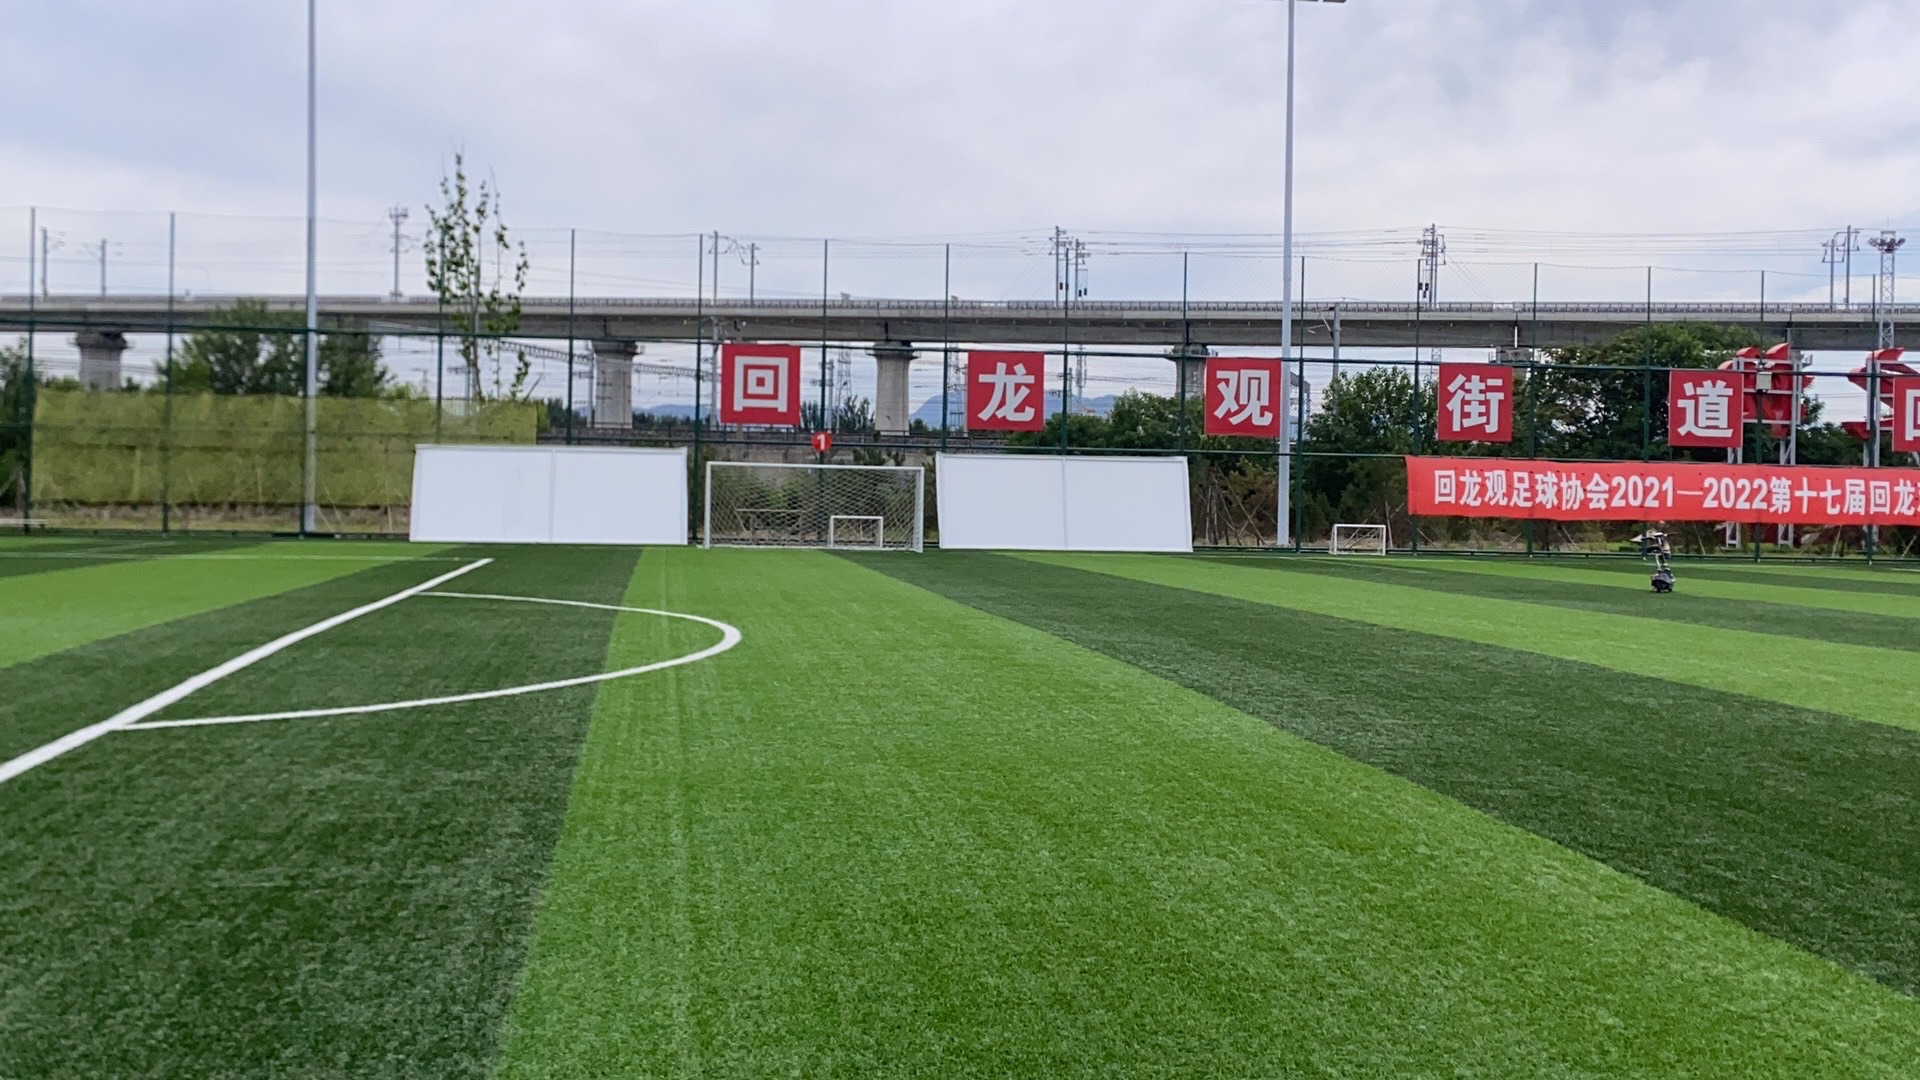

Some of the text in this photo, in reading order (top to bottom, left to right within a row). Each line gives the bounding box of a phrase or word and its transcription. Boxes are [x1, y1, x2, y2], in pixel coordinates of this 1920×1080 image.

[733, 356, 788, 412] 回
[978, 362, 1035, 421] 龙
[1213, 369, 1273, 426] 观
[1446, 374, 1505, 433] 街
[1677, 380, 1733, 438] 道
[816, 433, 825, 450] 1
[1434, 469, 1920, 516] 回龙观足球协会2021—2022第十七届回龙
